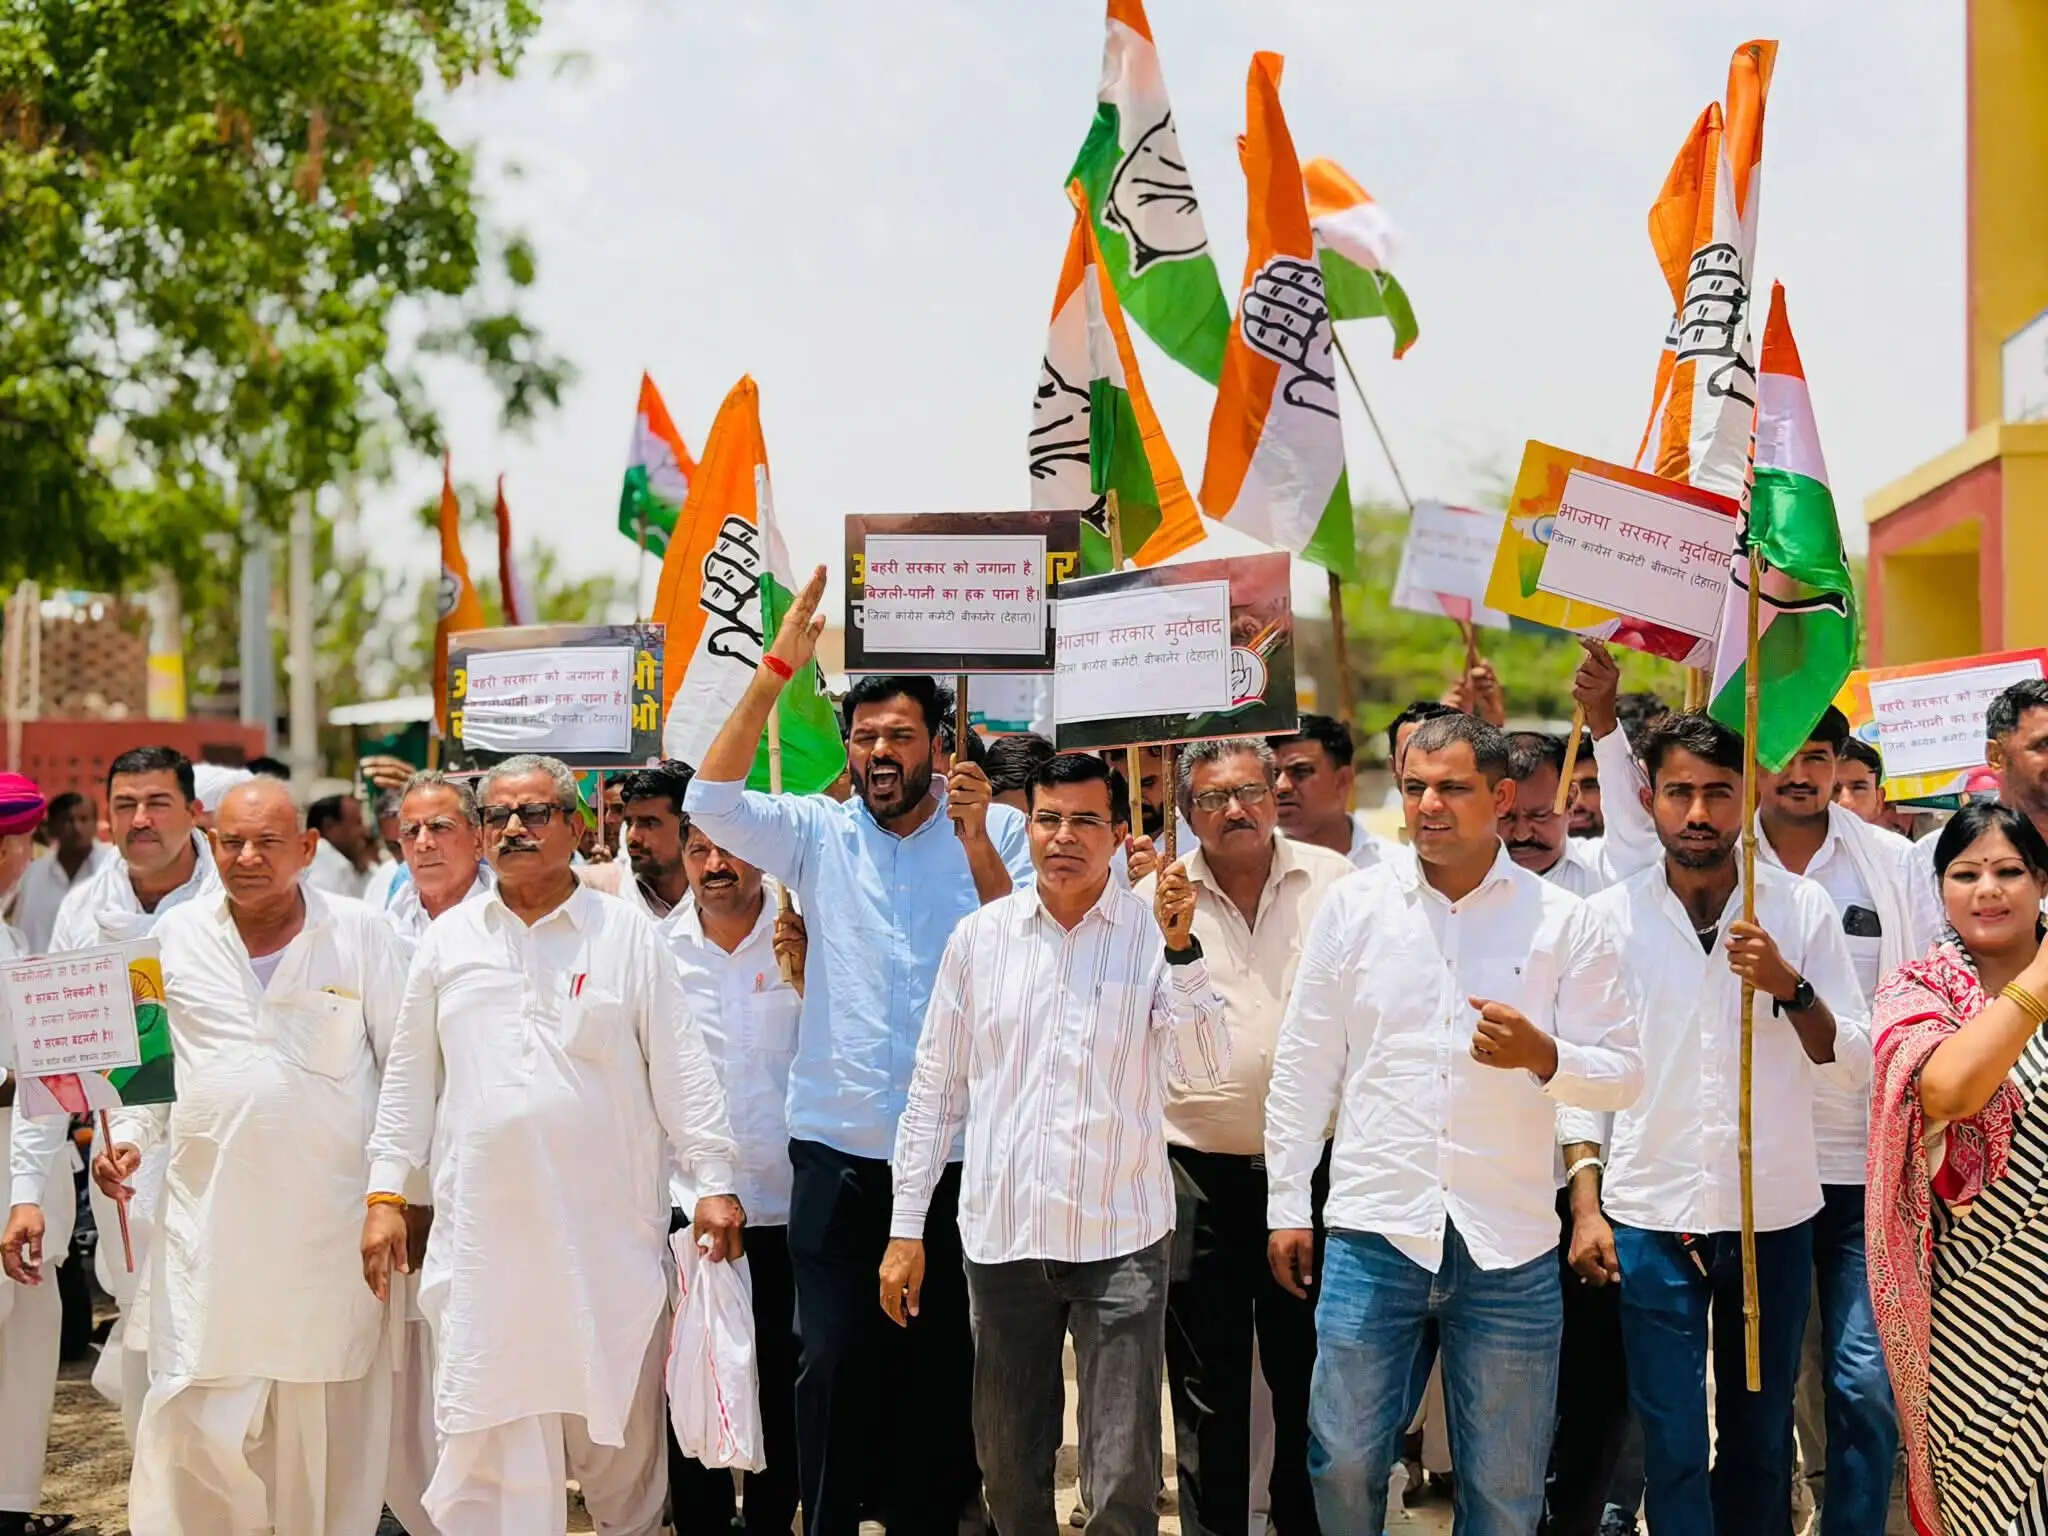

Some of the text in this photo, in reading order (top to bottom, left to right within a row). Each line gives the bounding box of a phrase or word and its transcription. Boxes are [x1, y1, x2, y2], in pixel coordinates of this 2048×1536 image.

[1560, 503, 1732, 571] भाजपा सरकार मुर्दाबाद
[1551, 529, 1577, 547] जिला
[1651, 560, 1688, 581] बीकानेर
[871, 559, 898, 576] बहरी
[905, 561, 946, 575] सरकार
[953, 559, 969, 575] को
[975, 563, 1016, 575] जगाना
[864, 584, 1040, 603] बिजली-पानी का हक पाना है।
[867, 607, 891, 621] जिला
[960, 609, 996, 622] बीकानेर
[1056, 614, 1224, 649] भाजपा सरकार मुर्दाबाद
[472, 673, 496, 689] बहरी
[503, 672, 540, 687] सरकार
[545, 667, 560, 681] को
[566, 670, 605, 682] जगाना
[1879, 697, 1904, 714] बहरी
[1912, 695, 1951, 709] सरकार
[1954, 690, 1971, 703] को
[1951, 714, 1966, 724] का
